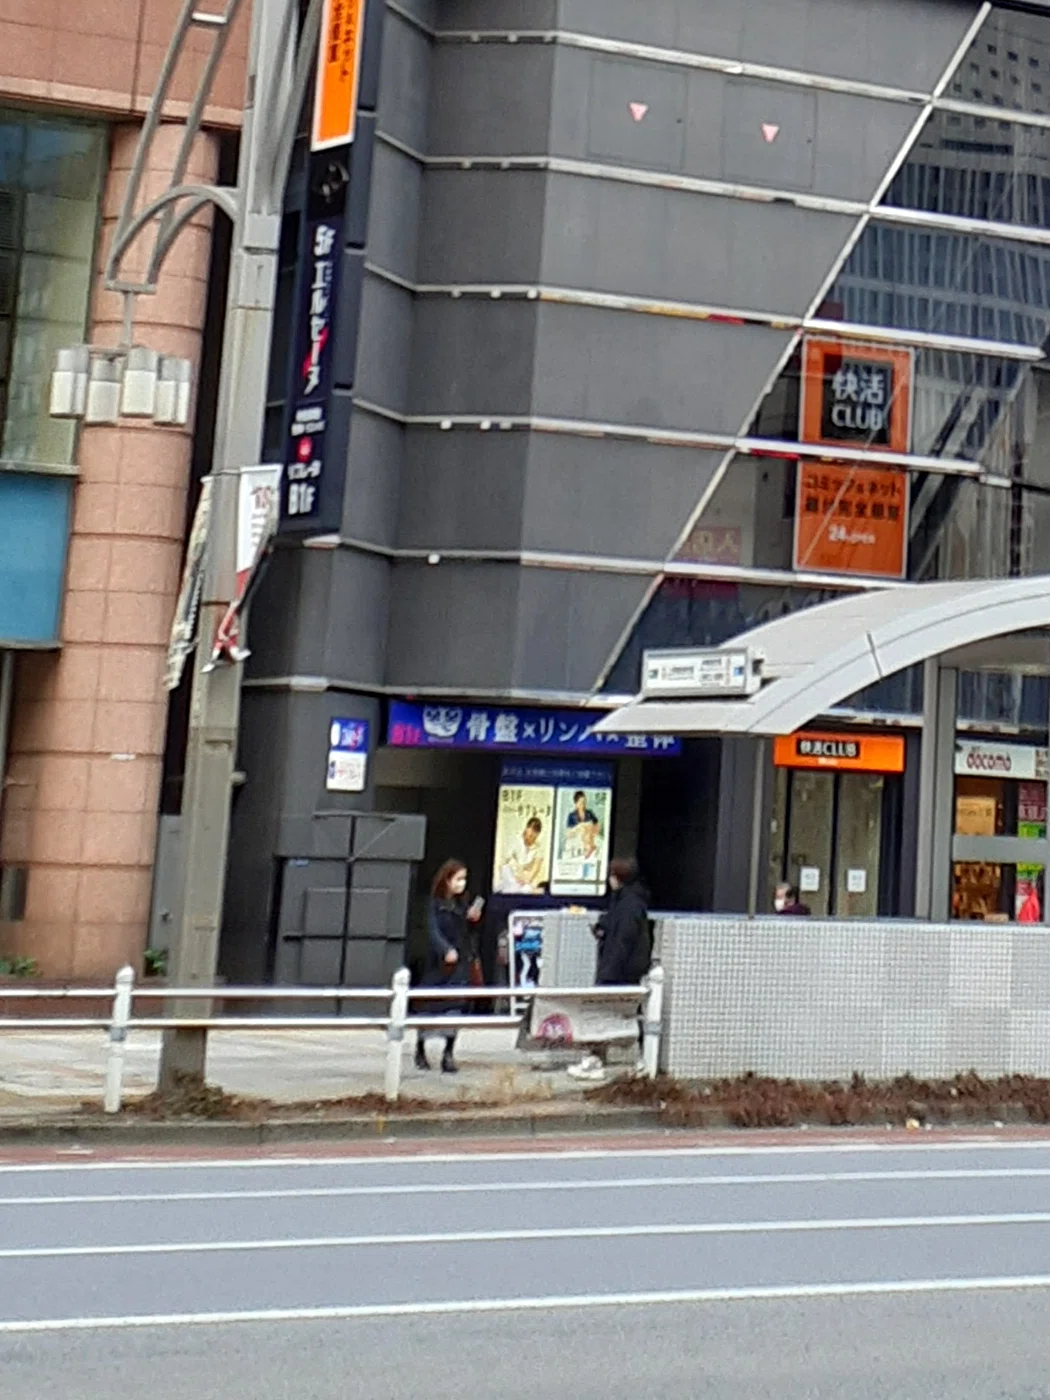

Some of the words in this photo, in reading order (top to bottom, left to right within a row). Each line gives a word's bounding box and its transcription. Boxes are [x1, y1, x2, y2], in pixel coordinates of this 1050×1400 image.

[831, 370, 884, 404] 快活
[831, 403, 884, 431] CLUB
[966, 752, 1012, 772] docomo
